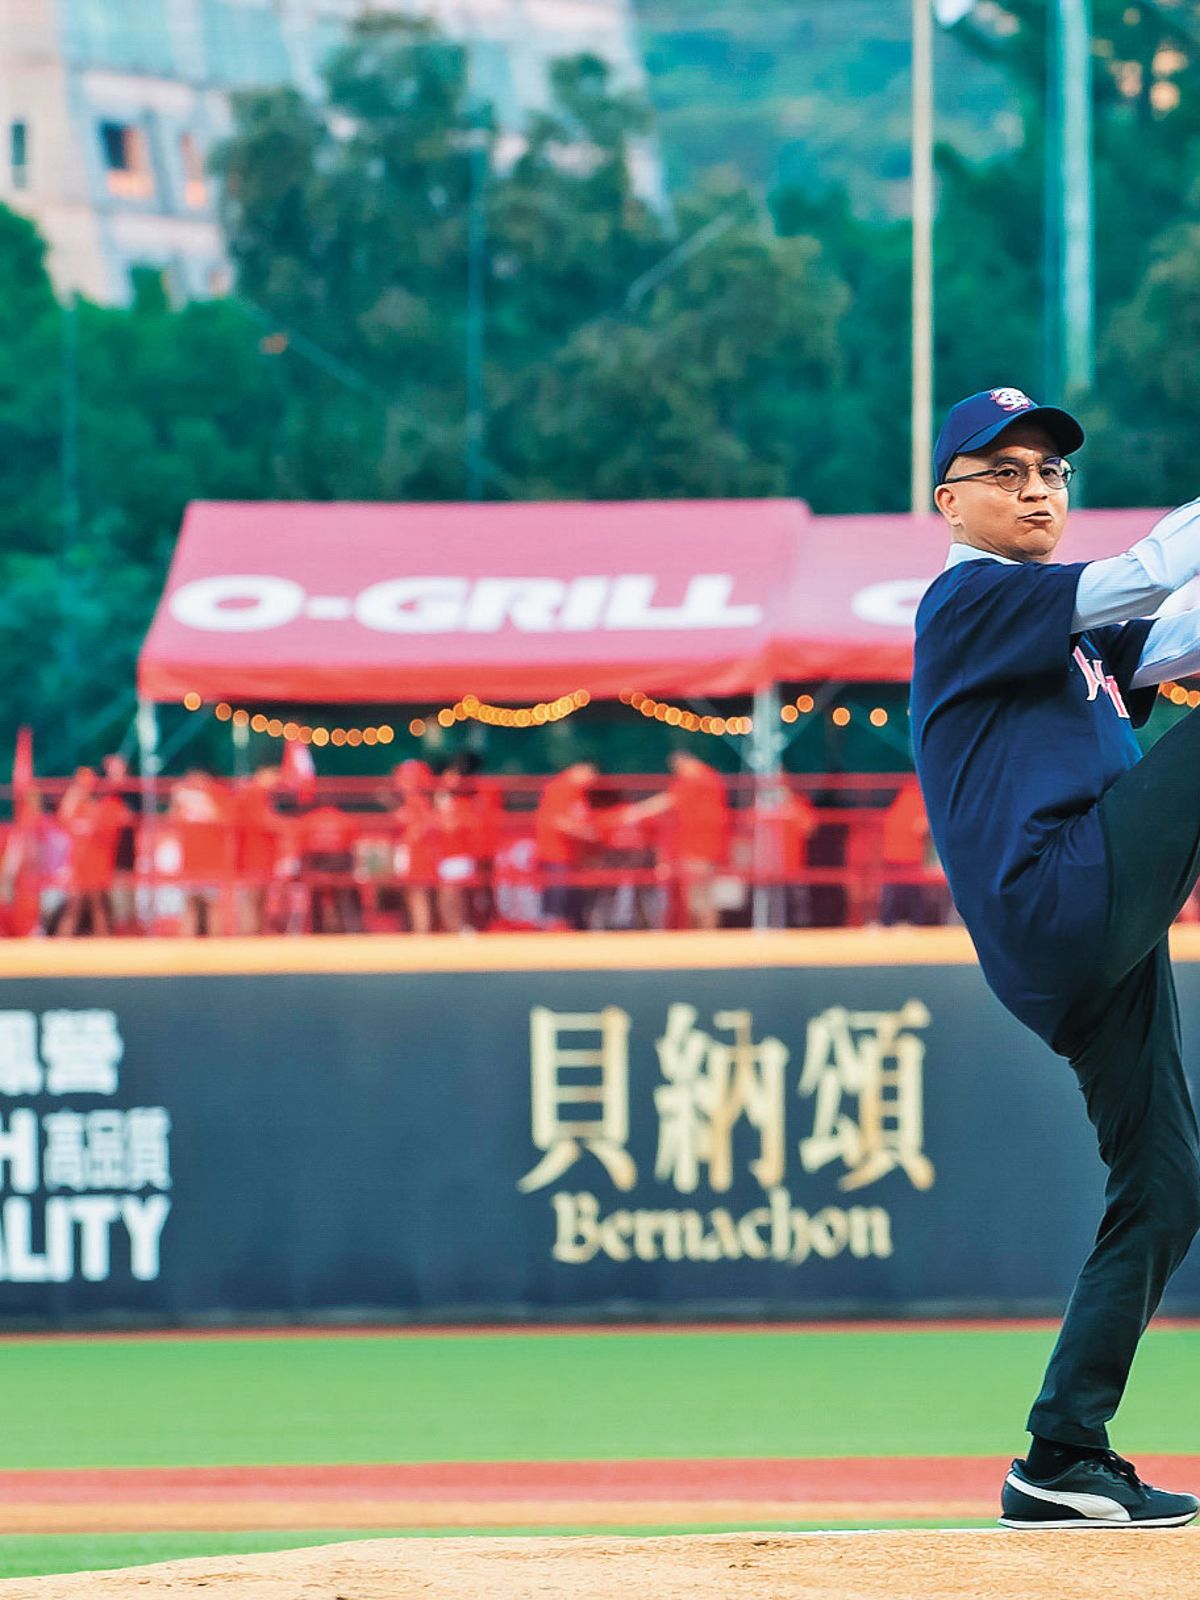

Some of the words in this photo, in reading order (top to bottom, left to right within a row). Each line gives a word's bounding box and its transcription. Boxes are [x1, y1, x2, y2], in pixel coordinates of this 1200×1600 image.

[168, 573, 765, 634] O-GRILL
[518, 1000, 935, 1192] 貝納頌
[43, 1106, 170, 1190] 高品質
[0, 1194, 170, 1282] LITY
[552, 1187, 893, 1264] Bernachon
